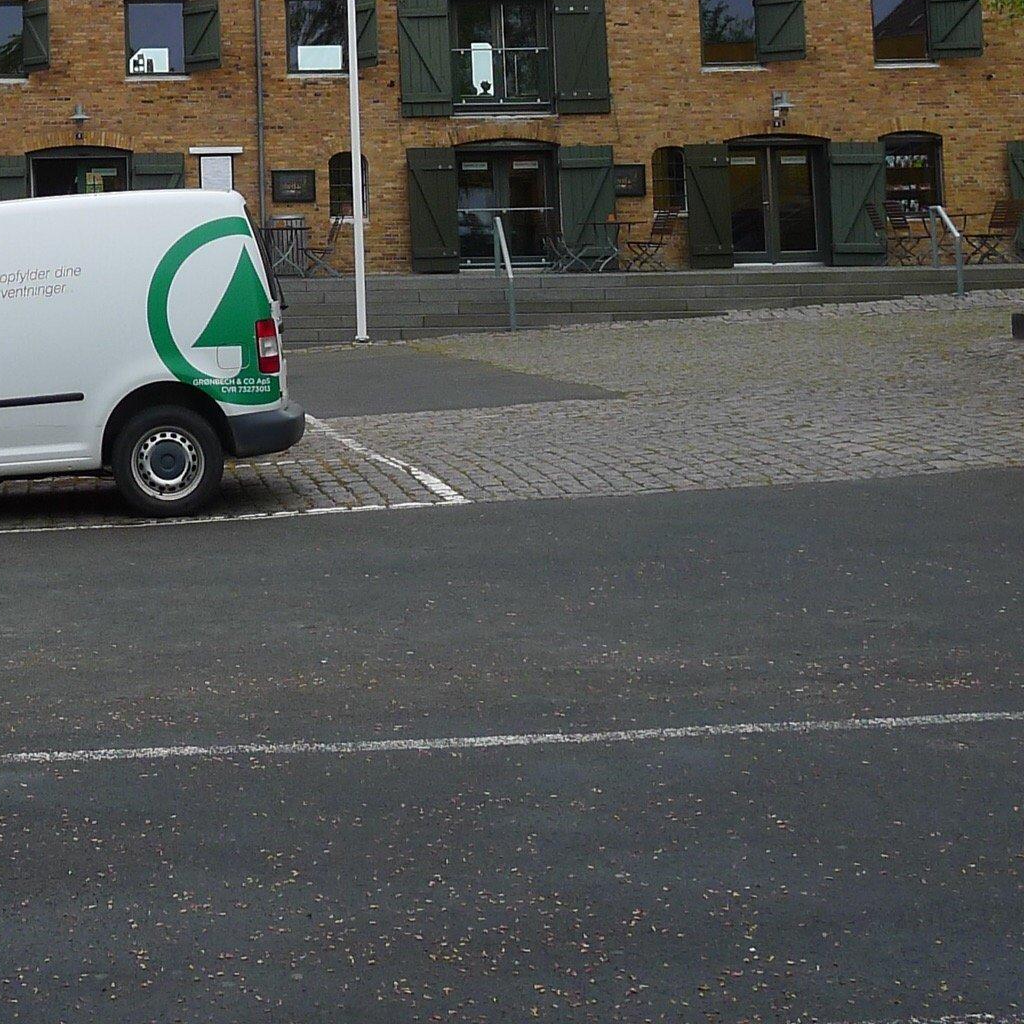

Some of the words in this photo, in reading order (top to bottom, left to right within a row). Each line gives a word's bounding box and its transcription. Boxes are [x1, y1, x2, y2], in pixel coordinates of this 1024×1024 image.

[0, 268, 51, 285] opfylder
[55, 265, 82, 279] dine
[192, 378, 235, 386] GRØNBECH
[256, 377, 271, 386] ApS
